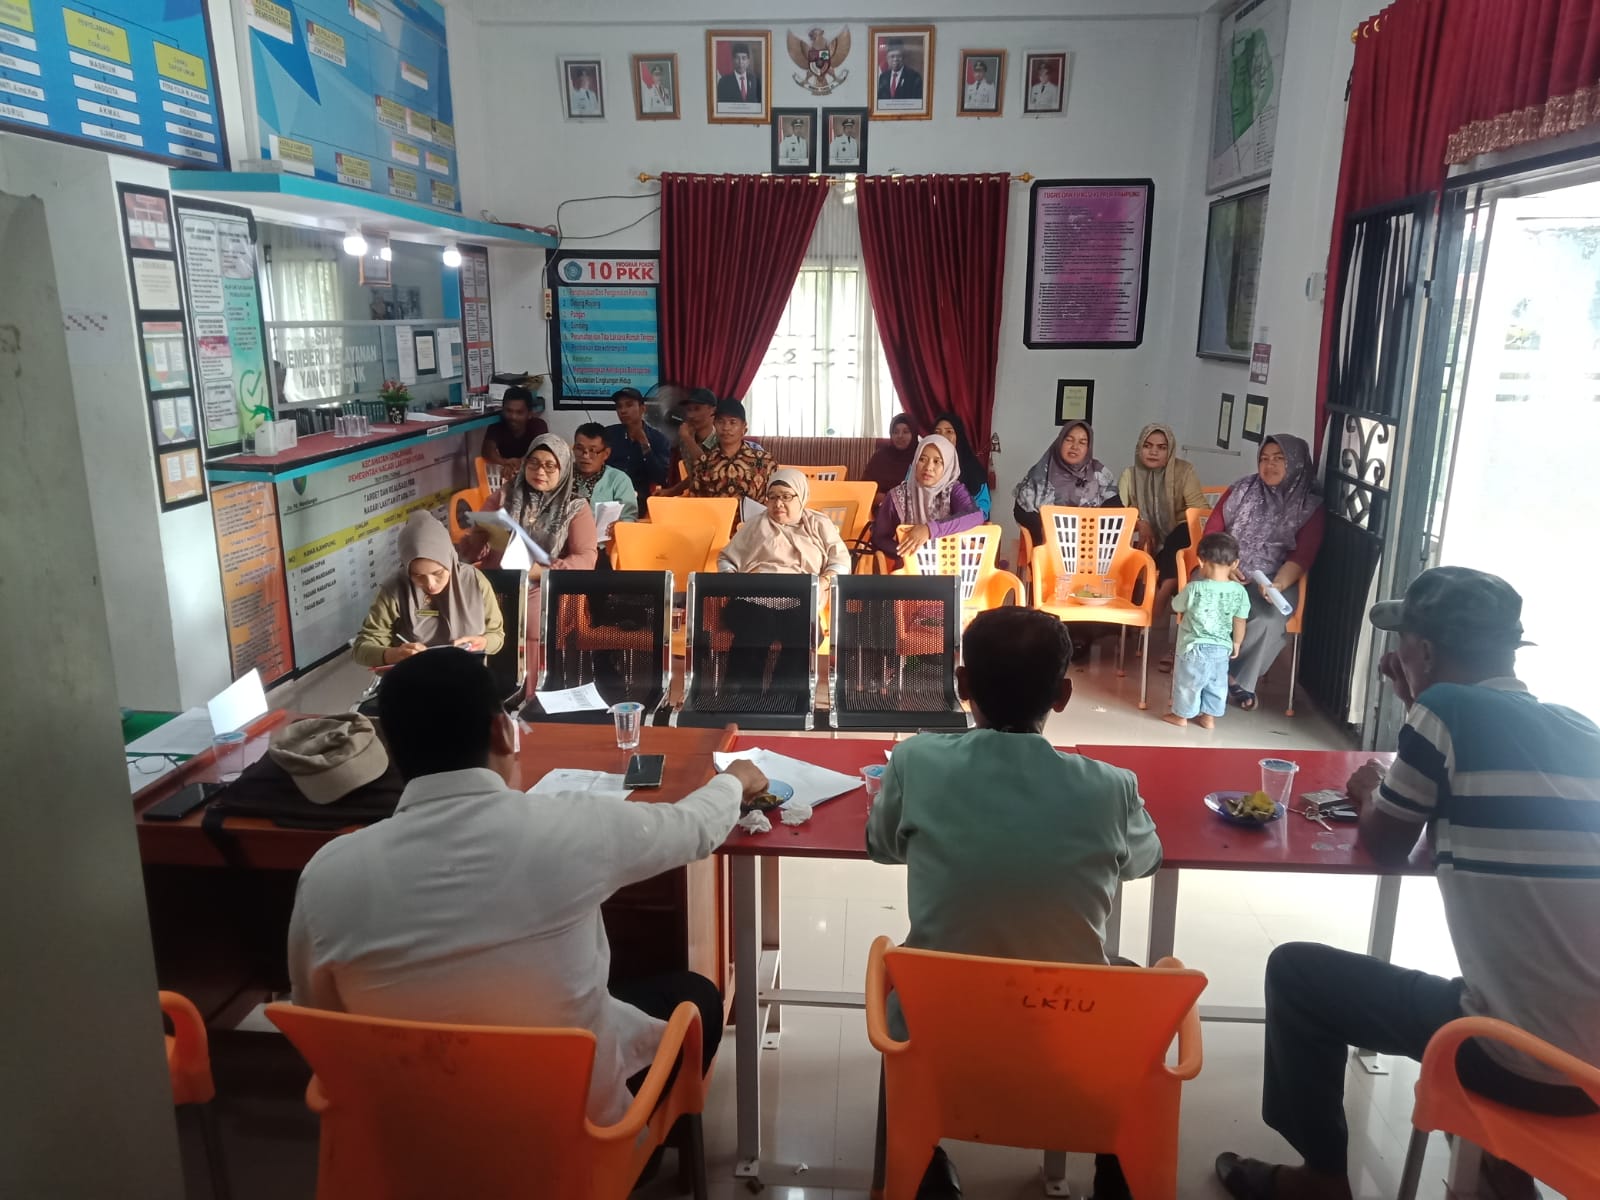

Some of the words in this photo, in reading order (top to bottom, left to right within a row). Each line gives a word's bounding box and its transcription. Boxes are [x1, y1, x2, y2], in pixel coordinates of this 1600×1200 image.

[588, 262, 612, 280] 10
[617, 267, 654, 280] PKK
[301, 369, 326, 389] YANG
[363, 489, 380, 502] TARGET
